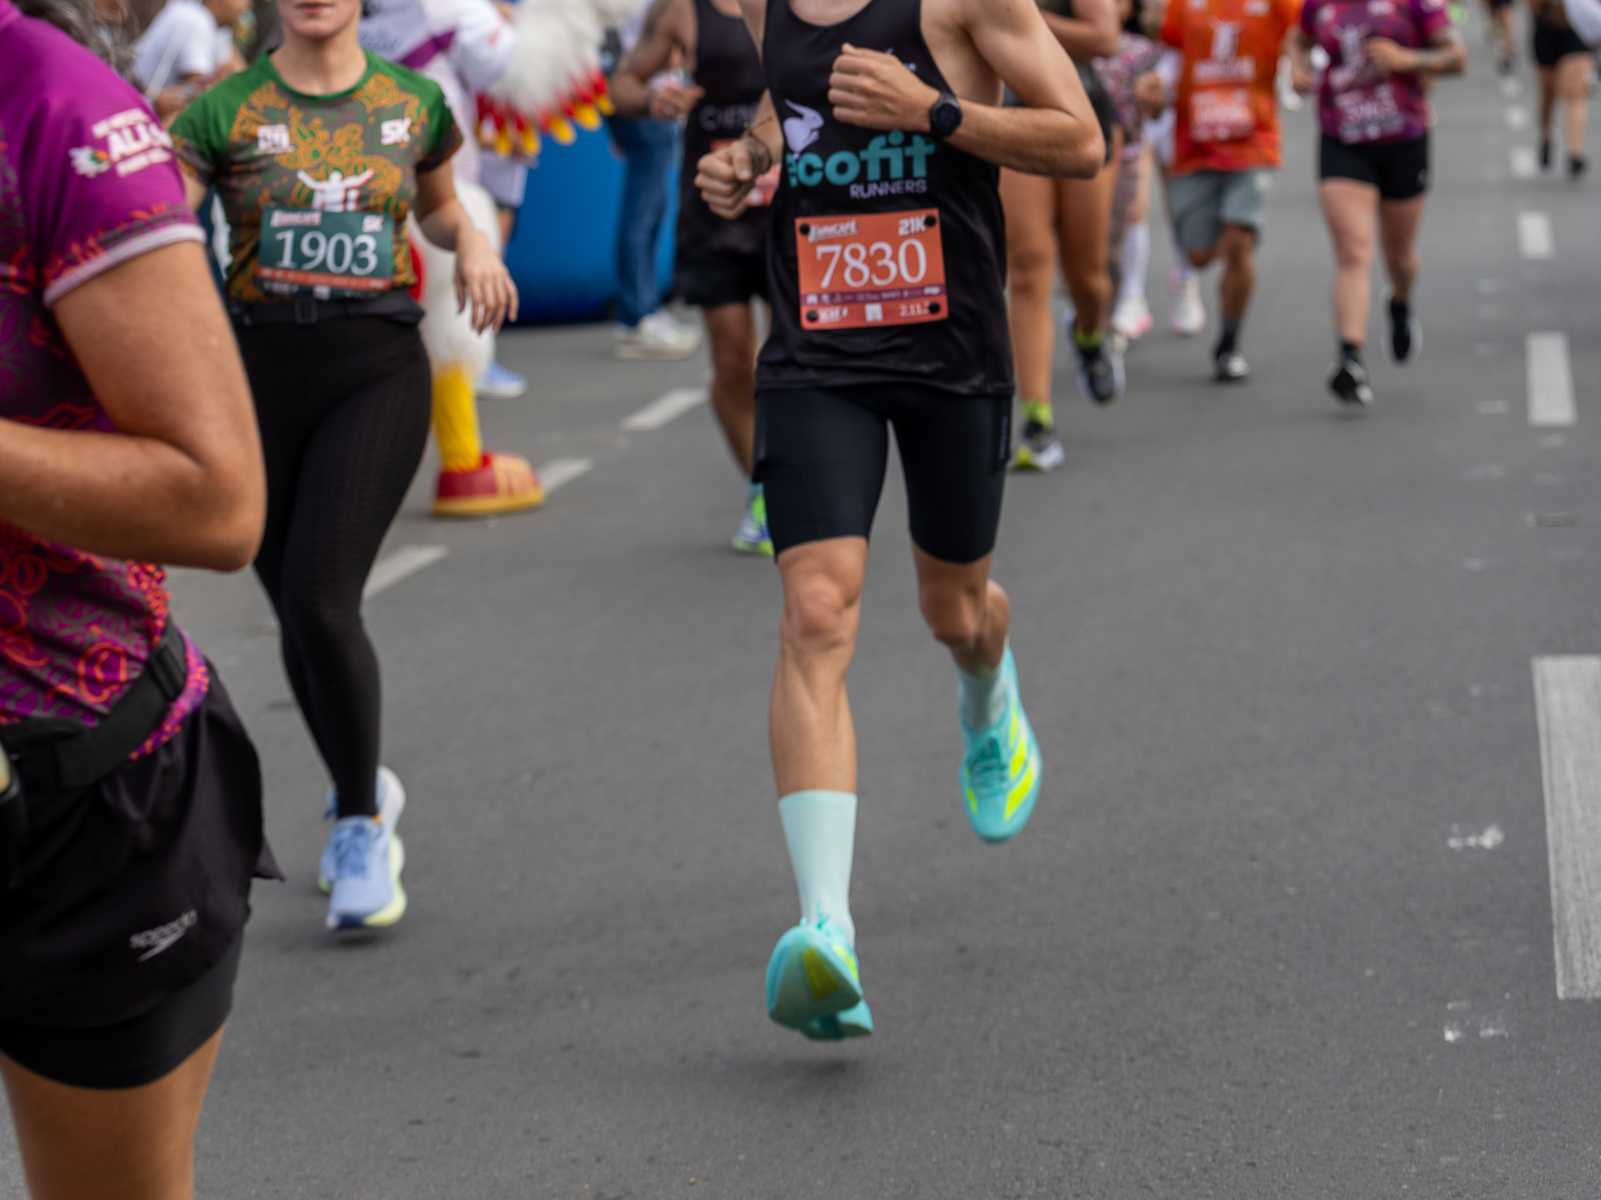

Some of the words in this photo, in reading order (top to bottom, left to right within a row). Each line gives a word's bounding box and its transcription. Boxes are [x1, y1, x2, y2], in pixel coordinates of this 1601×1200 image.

[850, 179, 928, 199] RUNNERS
[274, 229, 379, 277] 1903
[814, 238, 928, 290] 7830
